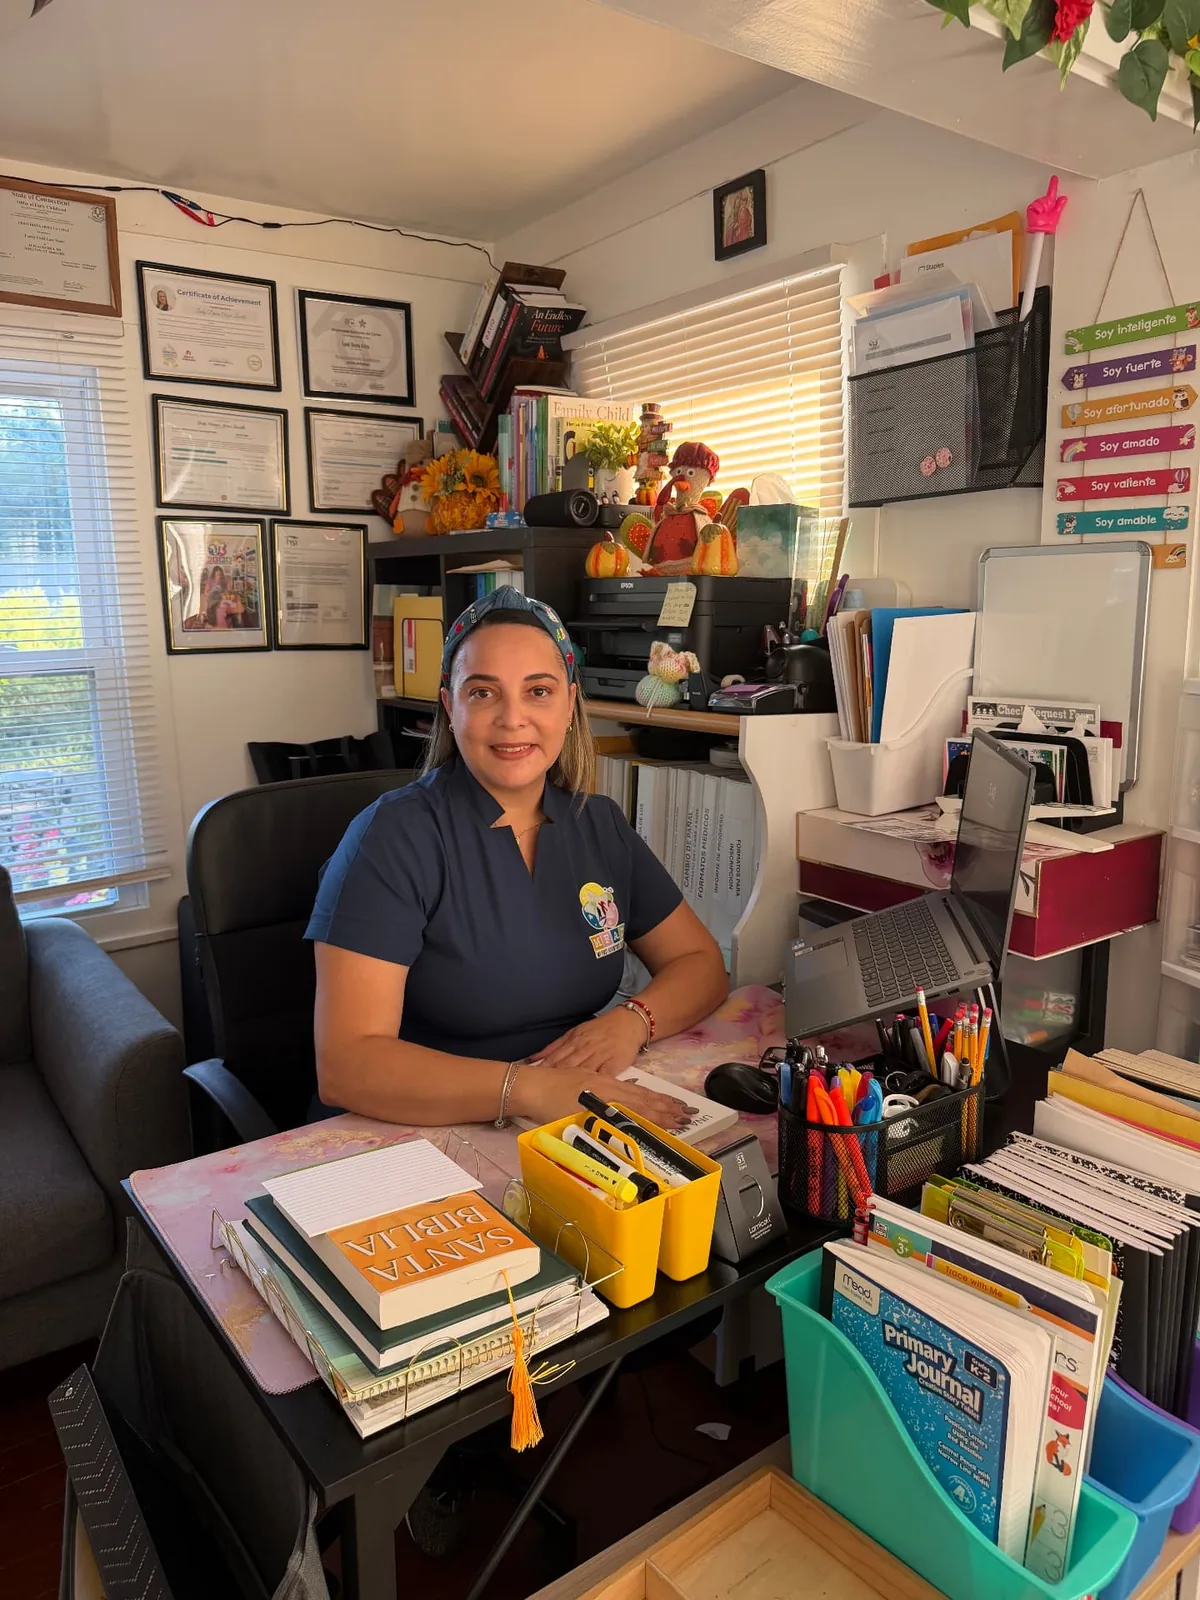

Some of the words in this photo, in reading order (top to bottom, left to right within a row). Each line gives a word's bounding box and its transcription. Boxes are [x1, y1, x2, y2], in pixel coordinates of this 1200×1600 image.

[926, 262, 944, 271] Staples
[177, 289, 212, 300] Certificate
[220, 295, 262, 306] Achievement
[531, 309, 545, 320] An
[544, 309, 572, 320] Endless
[530, 319, 565, 332] Future
[1095, 328, 1114, 340] Soy
[1117, 313, 1177, 332] inteligente
[1102, 366, 1122, 378] Soy
[1125, 358, 1162, 374] fuerte
[553, 401, 593, 419] Family
[596, 405, 630, 421] Child
[1083, 408, 1103, 419] Soy
[1105, 396, 1170, 416] afortunado
[1099, 441, 1120, 453] Soy
[1122, 436, 1160, 449] amado
[1091, 481, 1110, 492] Soy
[1113, 476, 1156, 489] valiente
[1095, 517, 1114, 528] Soy
[1117, 514, 1157, 526] amable
[701, 808, 710, 850] MEDICOS
[683, 854, 691, 888] CAMBIO
[697, 851, 706, 899] FORMATOS
[691, 1114, 713, 1126] UNA
[343, 1205, 490, 1257] BIBLIA
[364, 1227, 514, 1281] SANTA
[897, 1243, 910, 1254] 3+
[842, 1273, 871, 1299] mead
[945, 1265, 968, 1282] Trace
[970, 1277, 988, 1291] with
[990, 1286, 1004, 1298] Me
[884, 1323, 953, 1373] Primary
[970, 1364, 991, 1384] K-2
[971, 1357, 991, 1373] Grades
[907, 1352, 981, 1412] Journal
[1051, 1384, 1069, 1399] your
[942, 1389, 960, 1405] Story
[1050, 1393, 1072, 1412] chool
